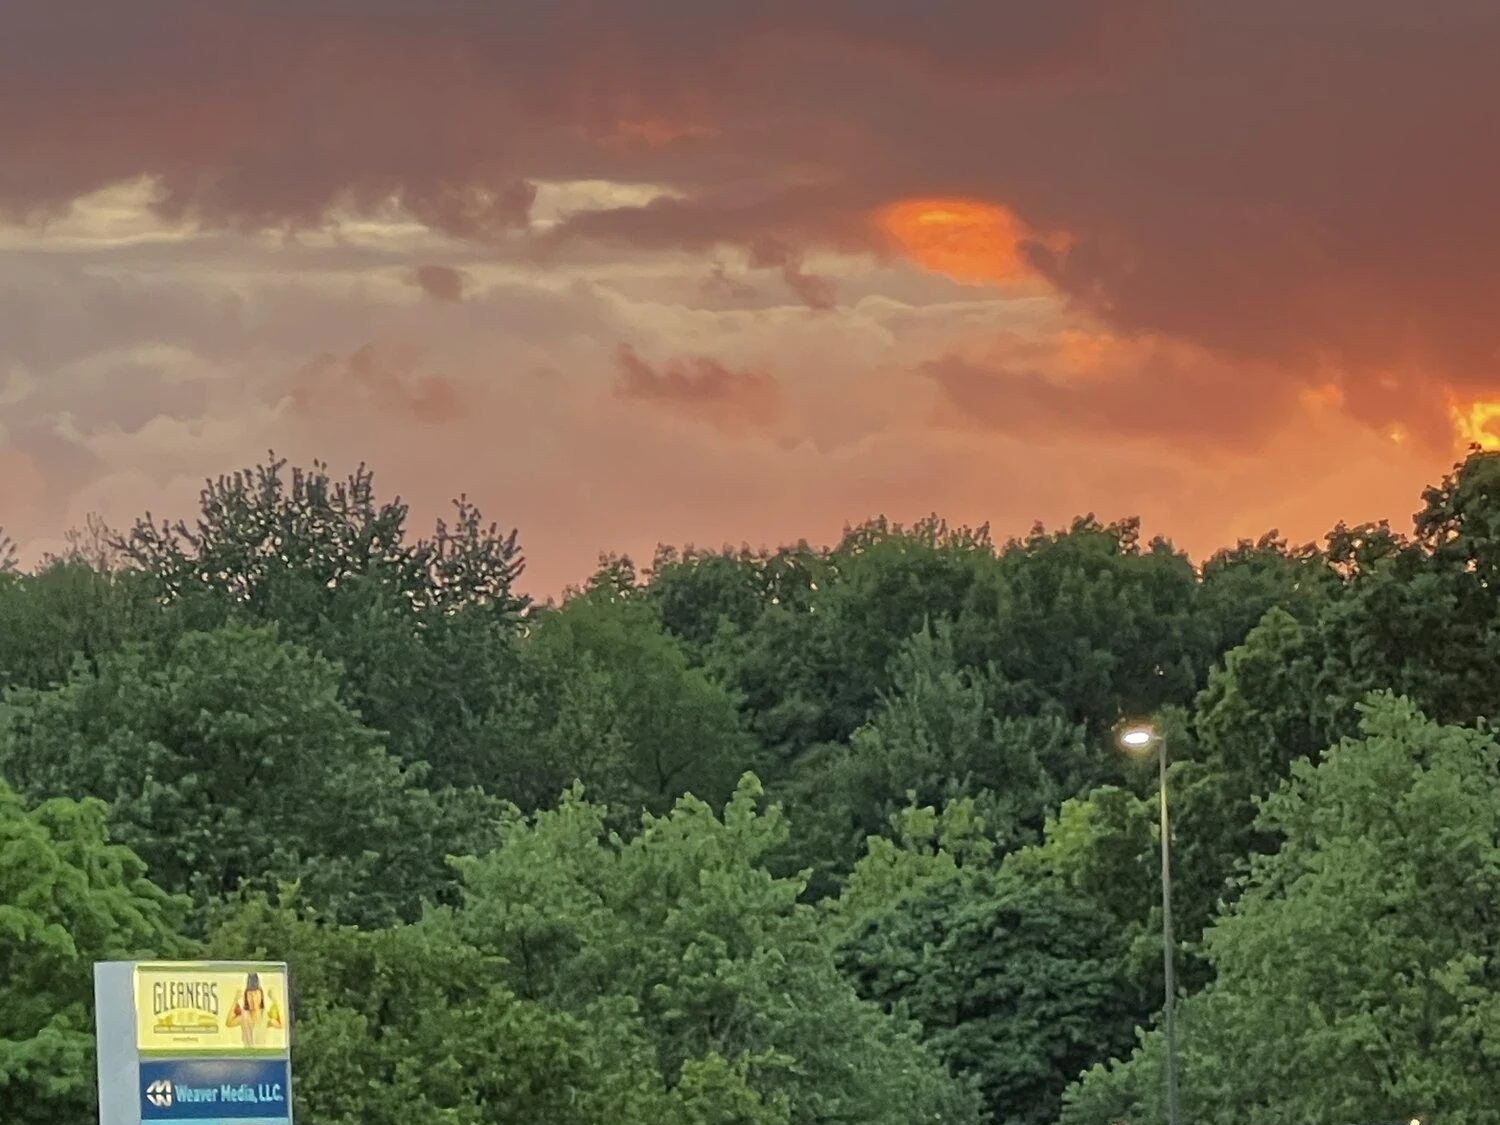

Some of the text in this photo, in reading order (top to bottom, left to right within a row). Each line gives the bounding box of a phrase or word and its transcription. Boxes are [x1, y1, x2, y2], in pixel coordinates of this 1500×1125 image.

[153, 981, 219, 1015] GLEANERS
[175, 1084, 218, 1102] Weaver
[220, 1084, 257, 1103] Media,
